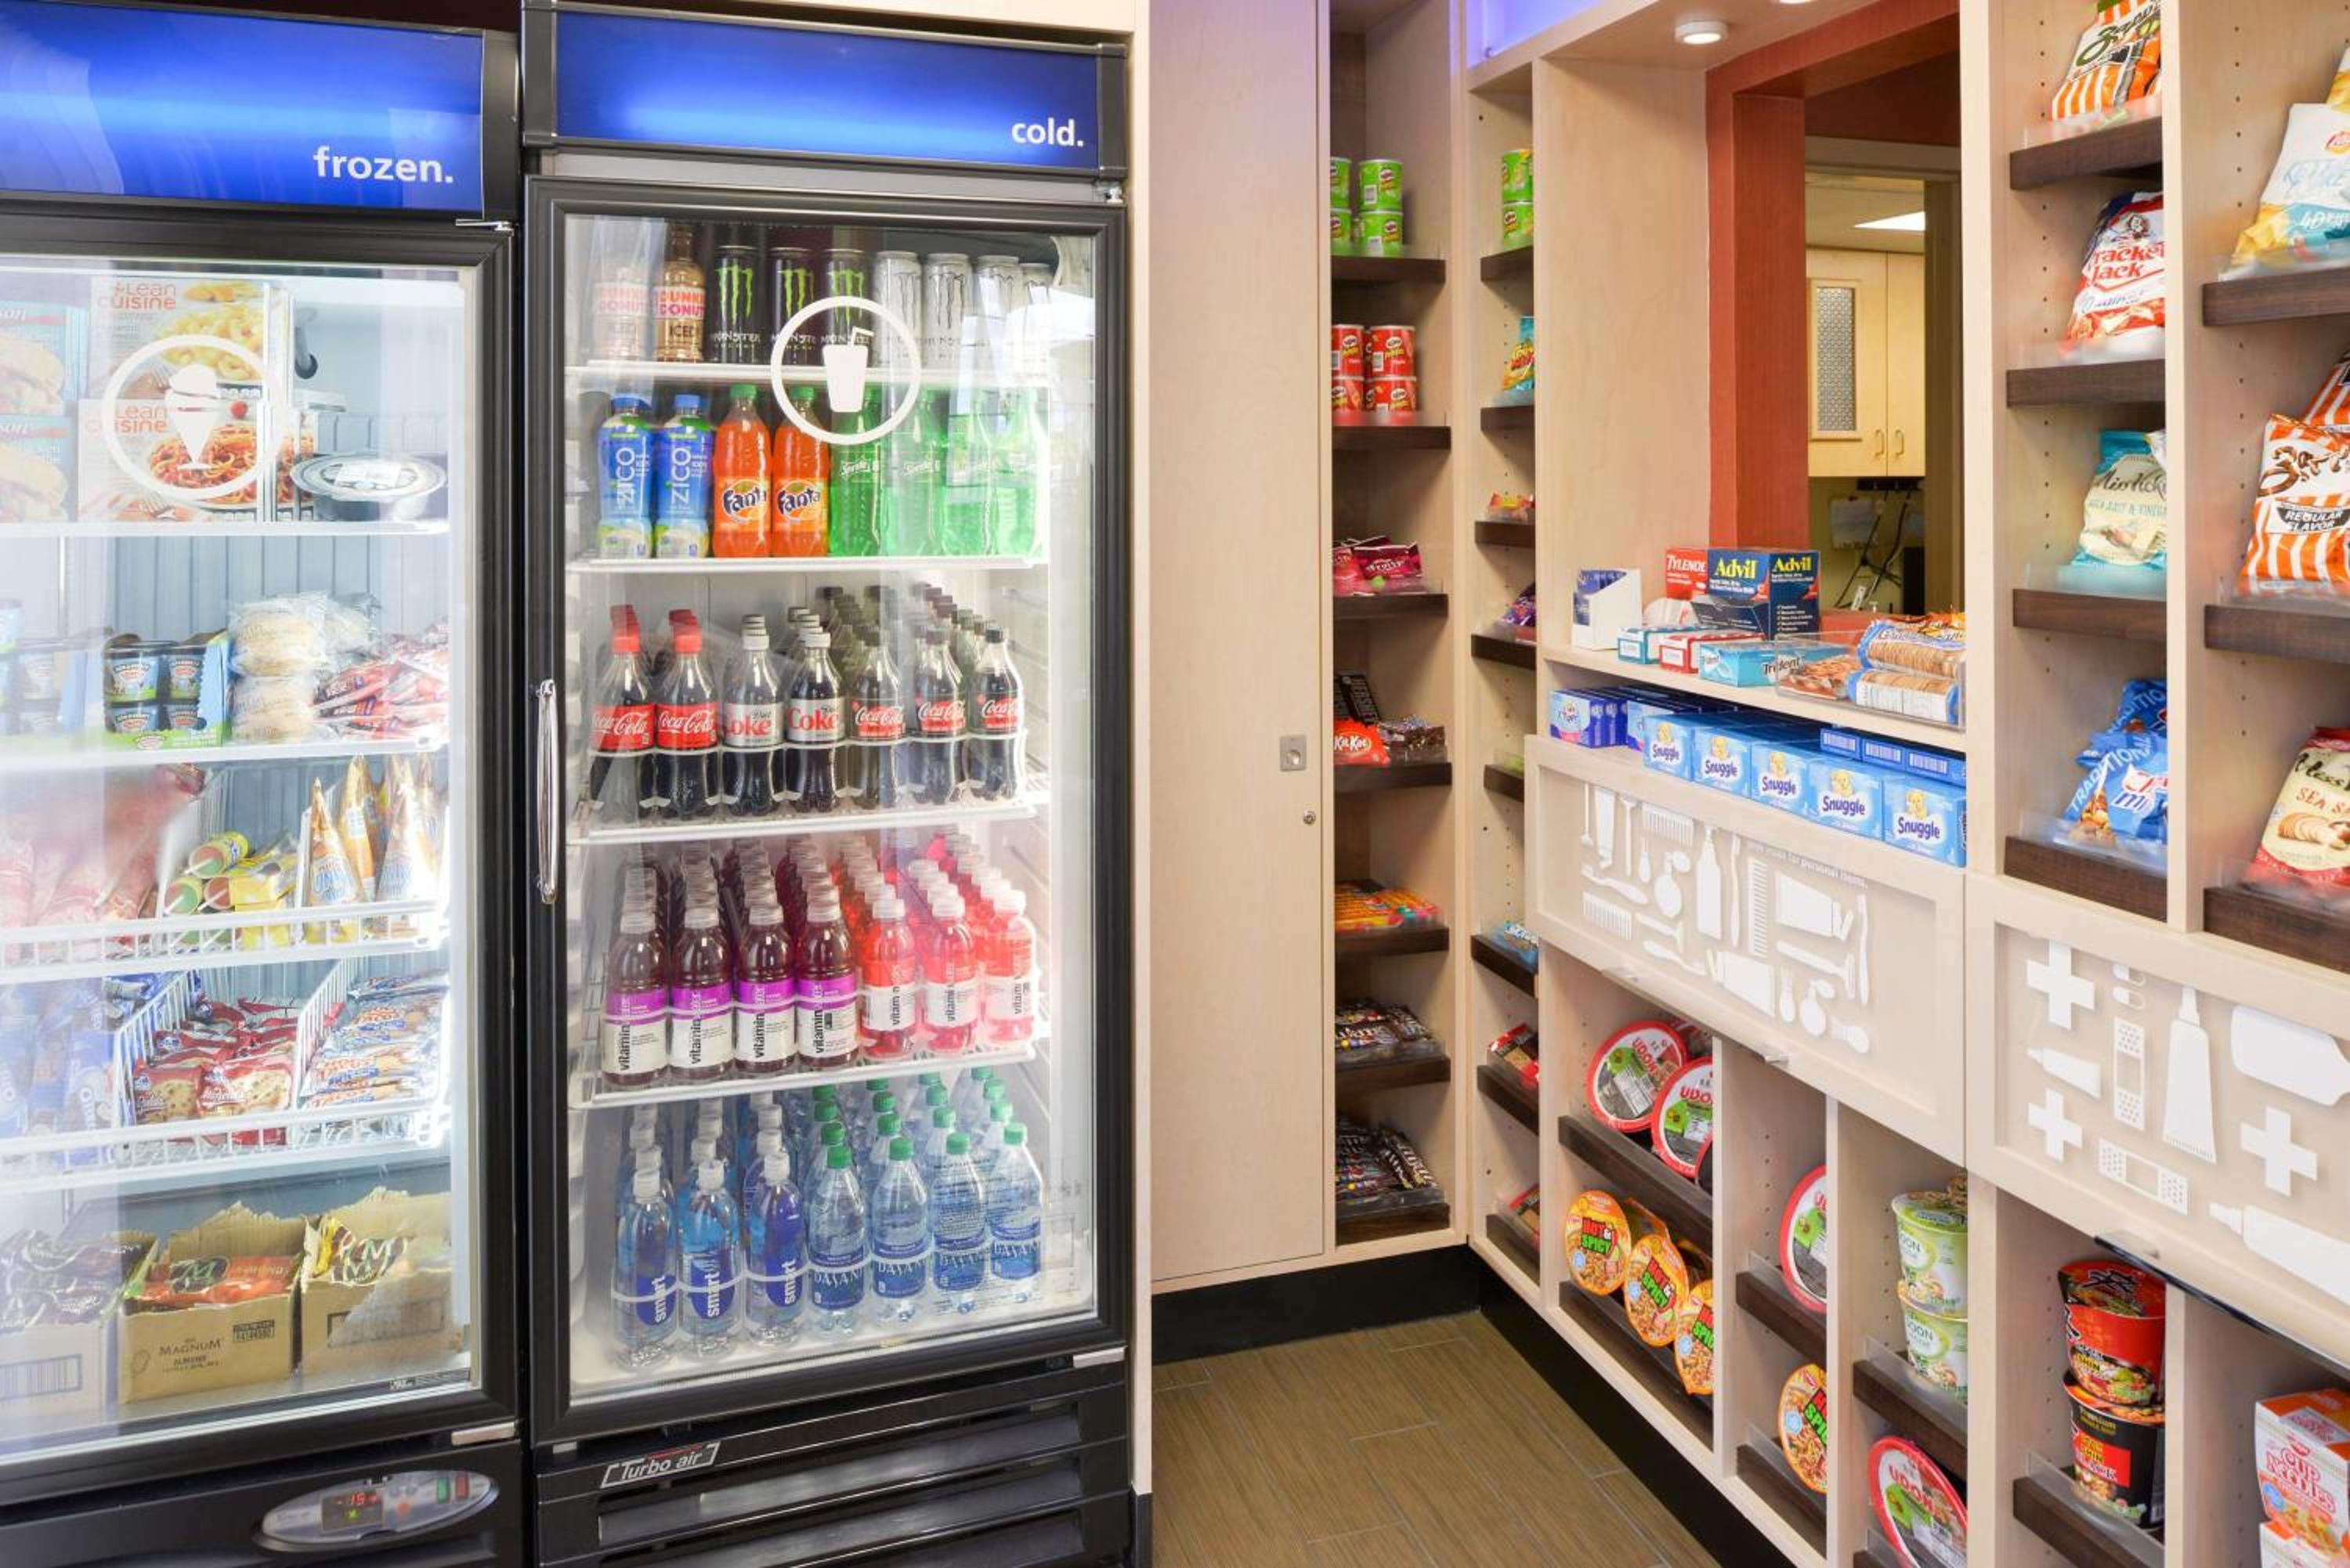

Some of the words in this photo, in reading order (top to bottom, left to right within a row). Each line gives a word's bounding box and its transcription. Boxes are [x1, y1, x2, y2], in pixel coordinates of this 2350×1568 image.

[1011, 117, 1083, 147] cold.
[313, 145, 454, 184] frozen.
[126, 282, 176, 296] Lean
[668, 323, 695, 338] ICED
[616, 447, 635, 506] ZICO
[671, 447, 692, 504] ZICO
[778, 489, 821, 515] Fanta
[2284, 509, 2343, 524] REGULAR
[1667, 554, 1707, 573] TYLENOL
[1714, 558, 1759, 580] Advil
[1773, 555, 1812, 573] Advil
[658, 710, 716, 734] Coca-Cola
[788, 706, 839, 732] Coke
[1652, 744, 1680, 762] Snuggle
[1705, 759, 1737, 778] Snuggle
[1762, 776, 1796, 796] Snuggle
[1822, 795, 1865, 817] Snuggle
[1898, 817, 1940, 840] Snuggle
[689, 1018, 702, 1065] vitamin
[753, 1013, 765, 1058] vitamin
[812, 1010, 824, 1054] vitamin
[618, 1024, 631, 1071] vitamin
[1680, 1086, 1712, 1104] UDO
[1582, 1217, 1606, 1236] HOT
[1581, 1234, 1611, 1254] SPICY
[782, 1258, 797, 1305] smart
[1642, 1270, 1668, 1309] SPICY
[652, 1274, 666, 1324] smart
[704, 1270, 720, 1318] smart
[159, 1339, 223, 1357] MAGNUM
[621, 1458, 672, 1480] Turbo
[676, 1451, 703, 1469] air
